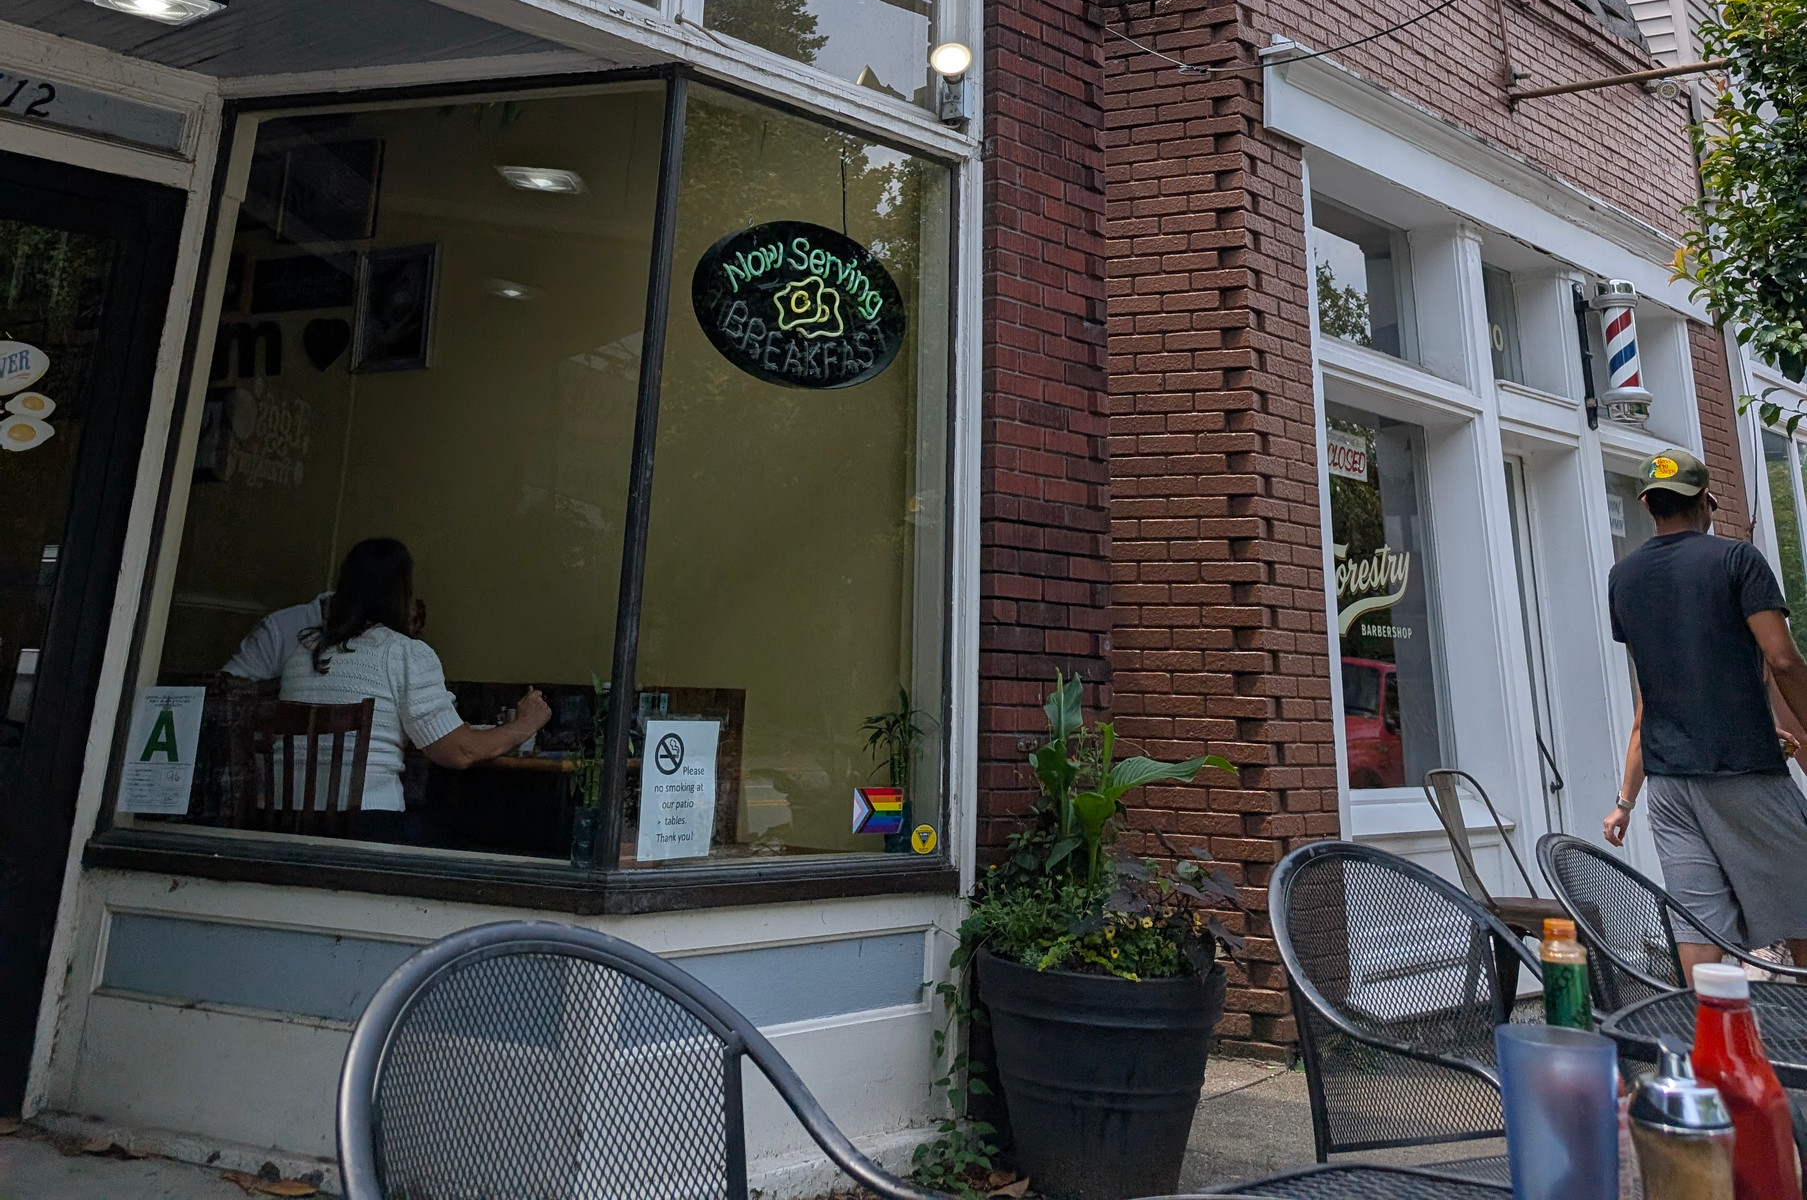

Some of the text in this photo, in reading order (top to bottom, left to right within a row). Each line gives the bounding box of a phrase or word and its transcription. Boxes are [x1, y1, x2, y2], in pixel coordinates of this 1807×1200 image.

[0, 72, 56, 117] 12
[722, 237, 884, 320] Now Serving
[718, 300, 887, 380] BREAKFAST
[1328, 442, 1366, 474] CLOSED
[1361, 623, 1413, 639] BARBERSHOP
[139, 710, 179, 763] A
[683, 766, 704, 775] Please
[654, 782, 704, 794] no smoking at
[662, 799, 694, 810] our patio
[664, 815, 687, 826] tables.
[656, 830, 694, 844] Thank you!
